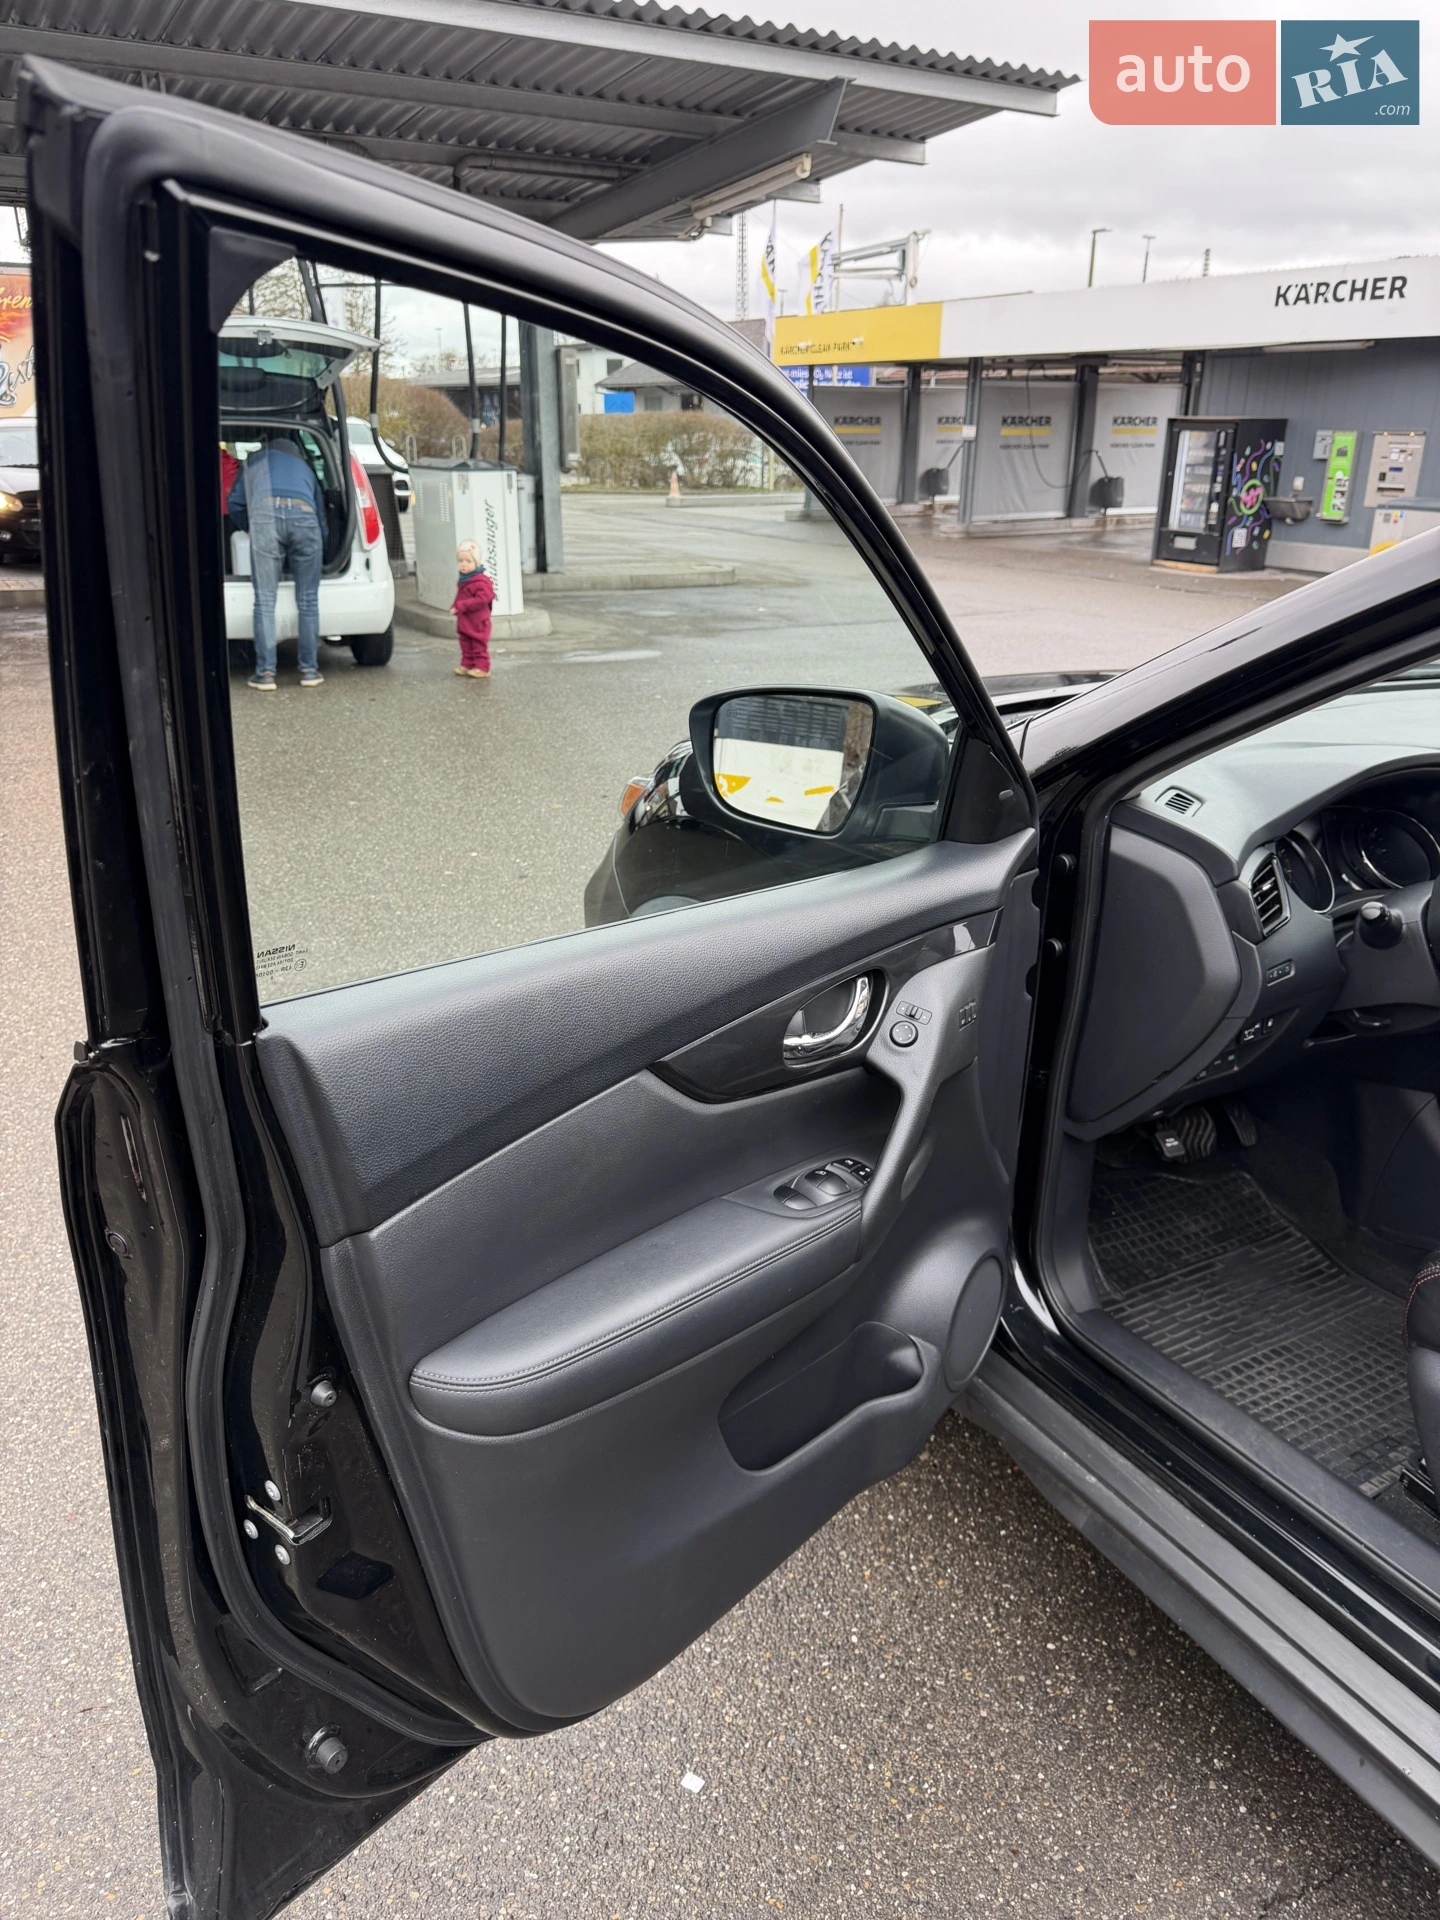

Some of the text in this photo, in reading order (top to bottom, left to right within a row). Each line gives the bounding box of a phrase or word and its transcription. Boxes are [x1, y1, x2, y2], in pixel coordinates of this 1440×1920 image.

[1274, 275, 1408, 307] KÄRCHER
[833, 415, 881, 426] KÄRCHER
[937, 415, 965, 425] KÄRC
[1001, 415, 1052, 427] KÄRCHER
[1112, 415, 1158, 427] KÄRCHER
